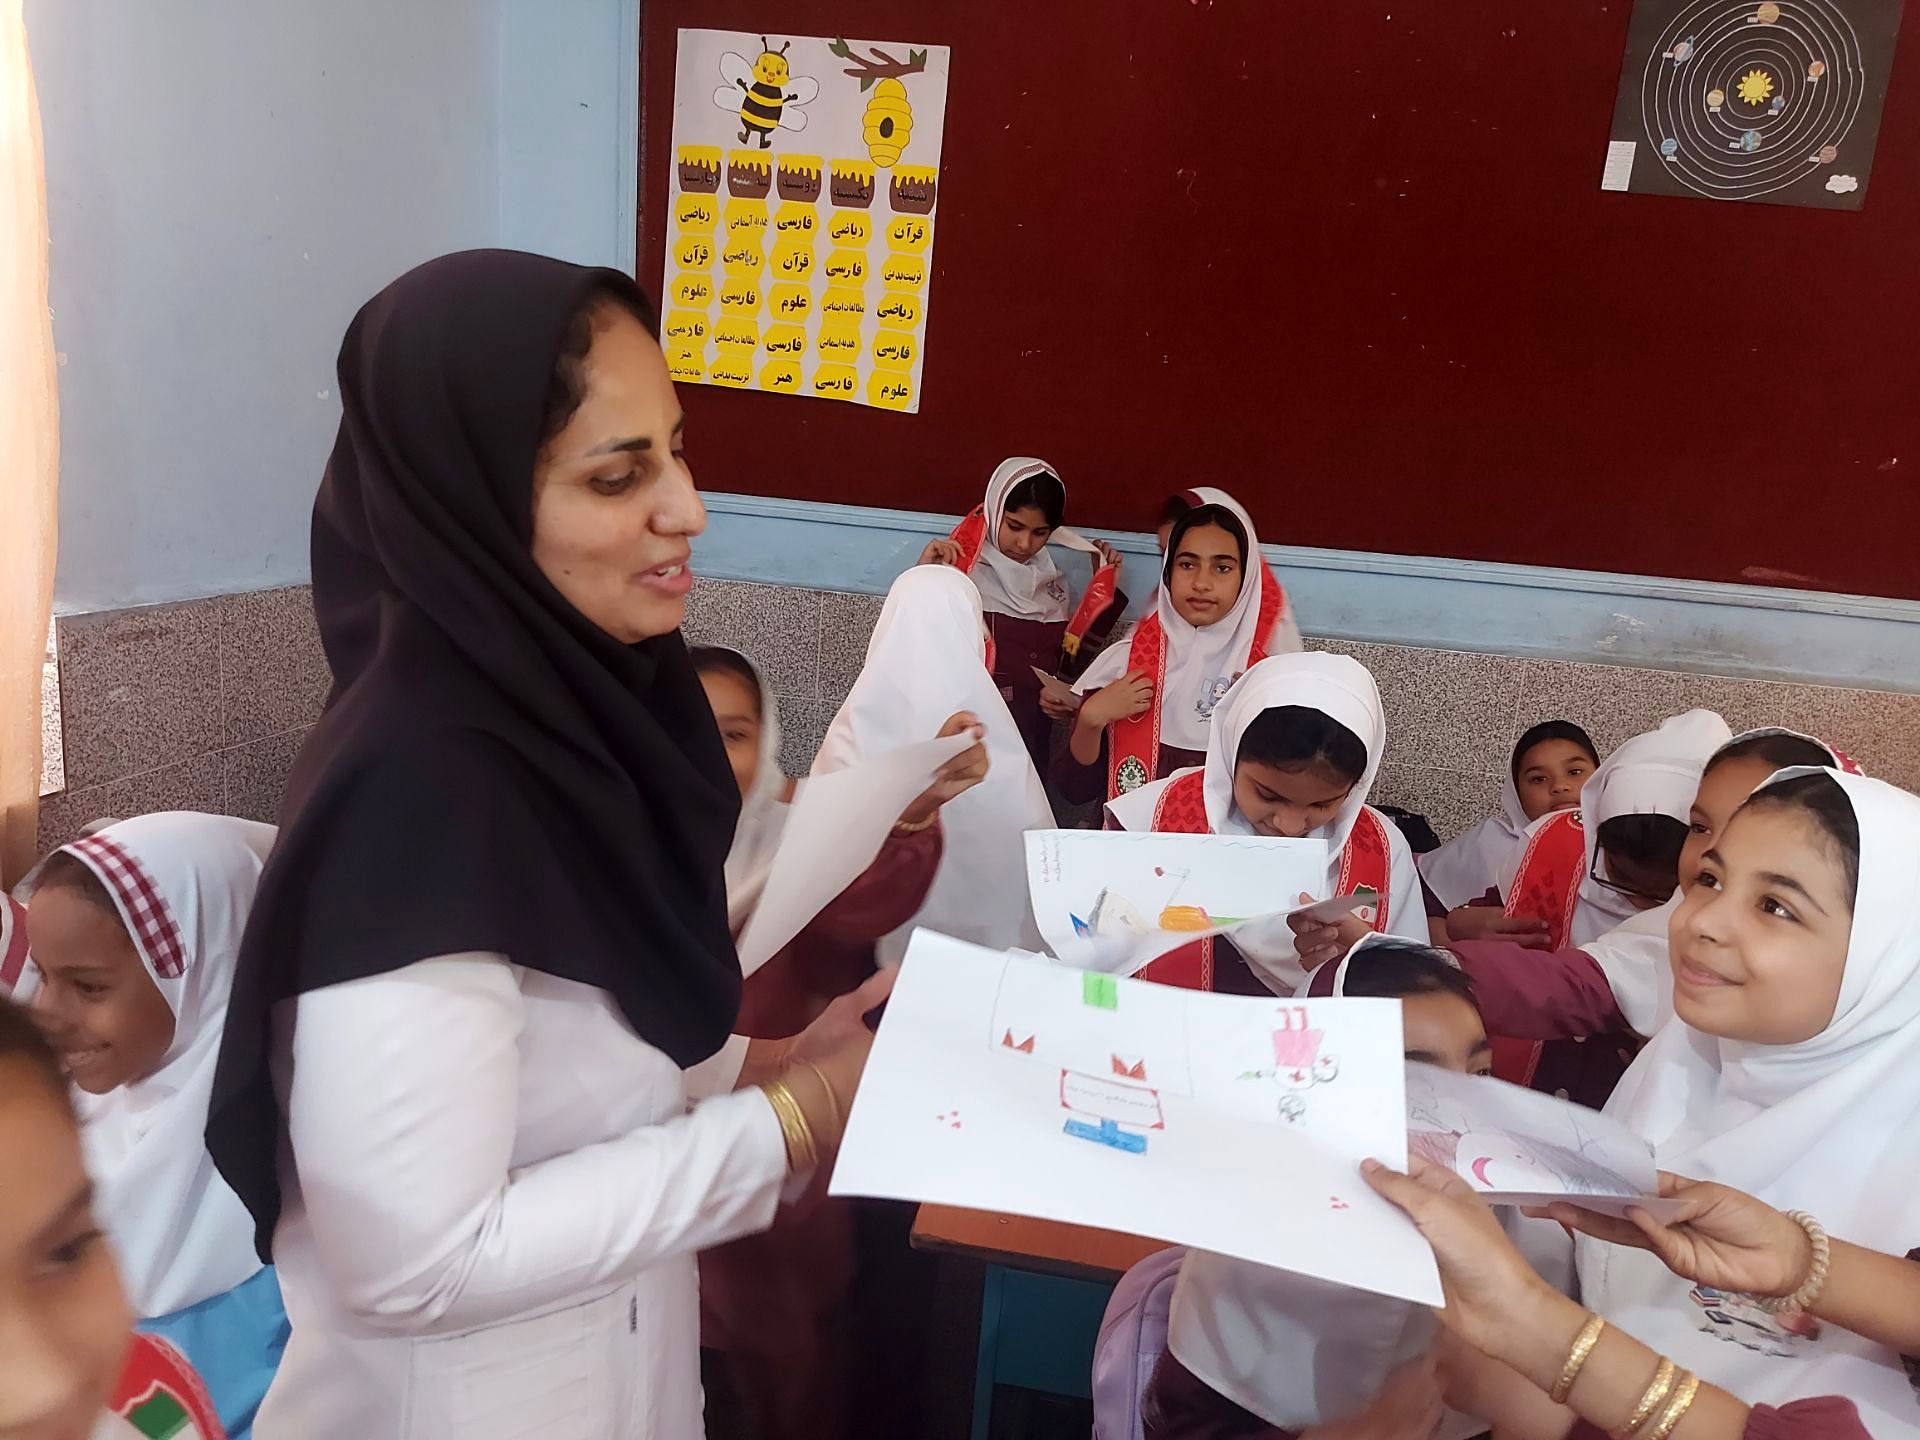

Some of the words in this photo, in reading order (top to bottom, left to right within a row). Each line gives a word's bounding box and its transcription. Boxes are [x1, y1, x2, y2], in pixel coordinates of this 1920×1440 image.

[897, 188, 928, 205] شنبه
[680, 206, 710, 225] ریاضی
[777, 215, 813, 230] فارسی
[831, 222, 864, 240] ریاضی
[894, 222, 924, 244] قرآن
[683, 244, 709, 265] قرآن
[723, 249, 759, 266] ریاضی
[783, 252, 809, 272] قرآن
[826, 261, 862, 279] فارسی
[681, 281, 707, 300] علوم
[720, 290, 756, 305] فارسی
[781, 294, 807, 313] علوم
[876, 302, 914, 322] ریاضی
[667, 322, 704, 337] فارسی
[766, 336, 802, 352] فارسی
[876, 345, 910, 360] فارسی
[680, 349, 692, 360] هنر
[773, 372, 793, 386] هنر
[815, 375, 853, 390] فارسی
[881, 383, 909, 400] علوم
